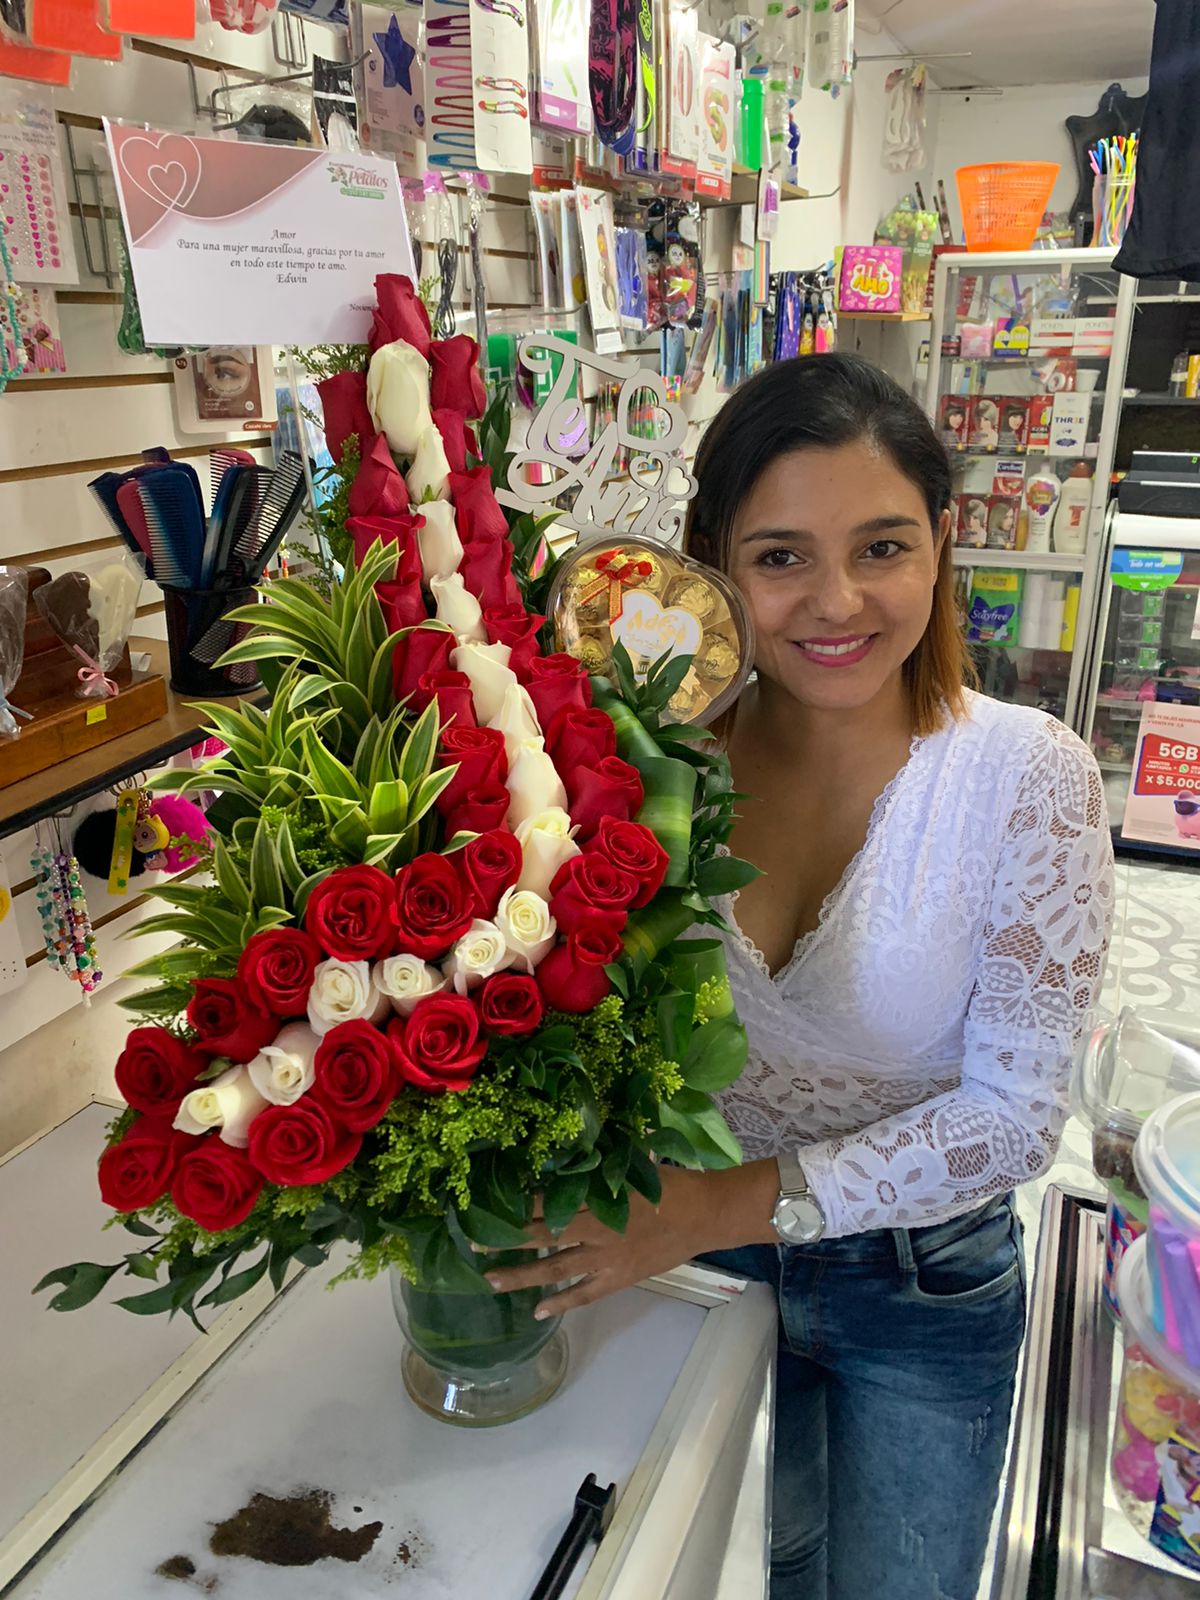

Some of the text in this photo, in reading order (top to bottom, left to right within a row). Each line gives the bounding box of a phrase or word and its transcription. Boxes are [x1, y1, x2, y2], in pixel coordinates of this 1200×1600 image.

[271, 229, 296, 240] Amor
[177, 239, 385, 260] Para una mujer maravillosa, gracias por tu amor
[230, 257, 347, 272] en todo este tiempo te amo.
[276, 272, 307, 284] Edwin
[853, 273, 889, 296] AMO
[970, 608, 1009, 624] Stayfree
[1159, 742, 1198, 761] 5GB
